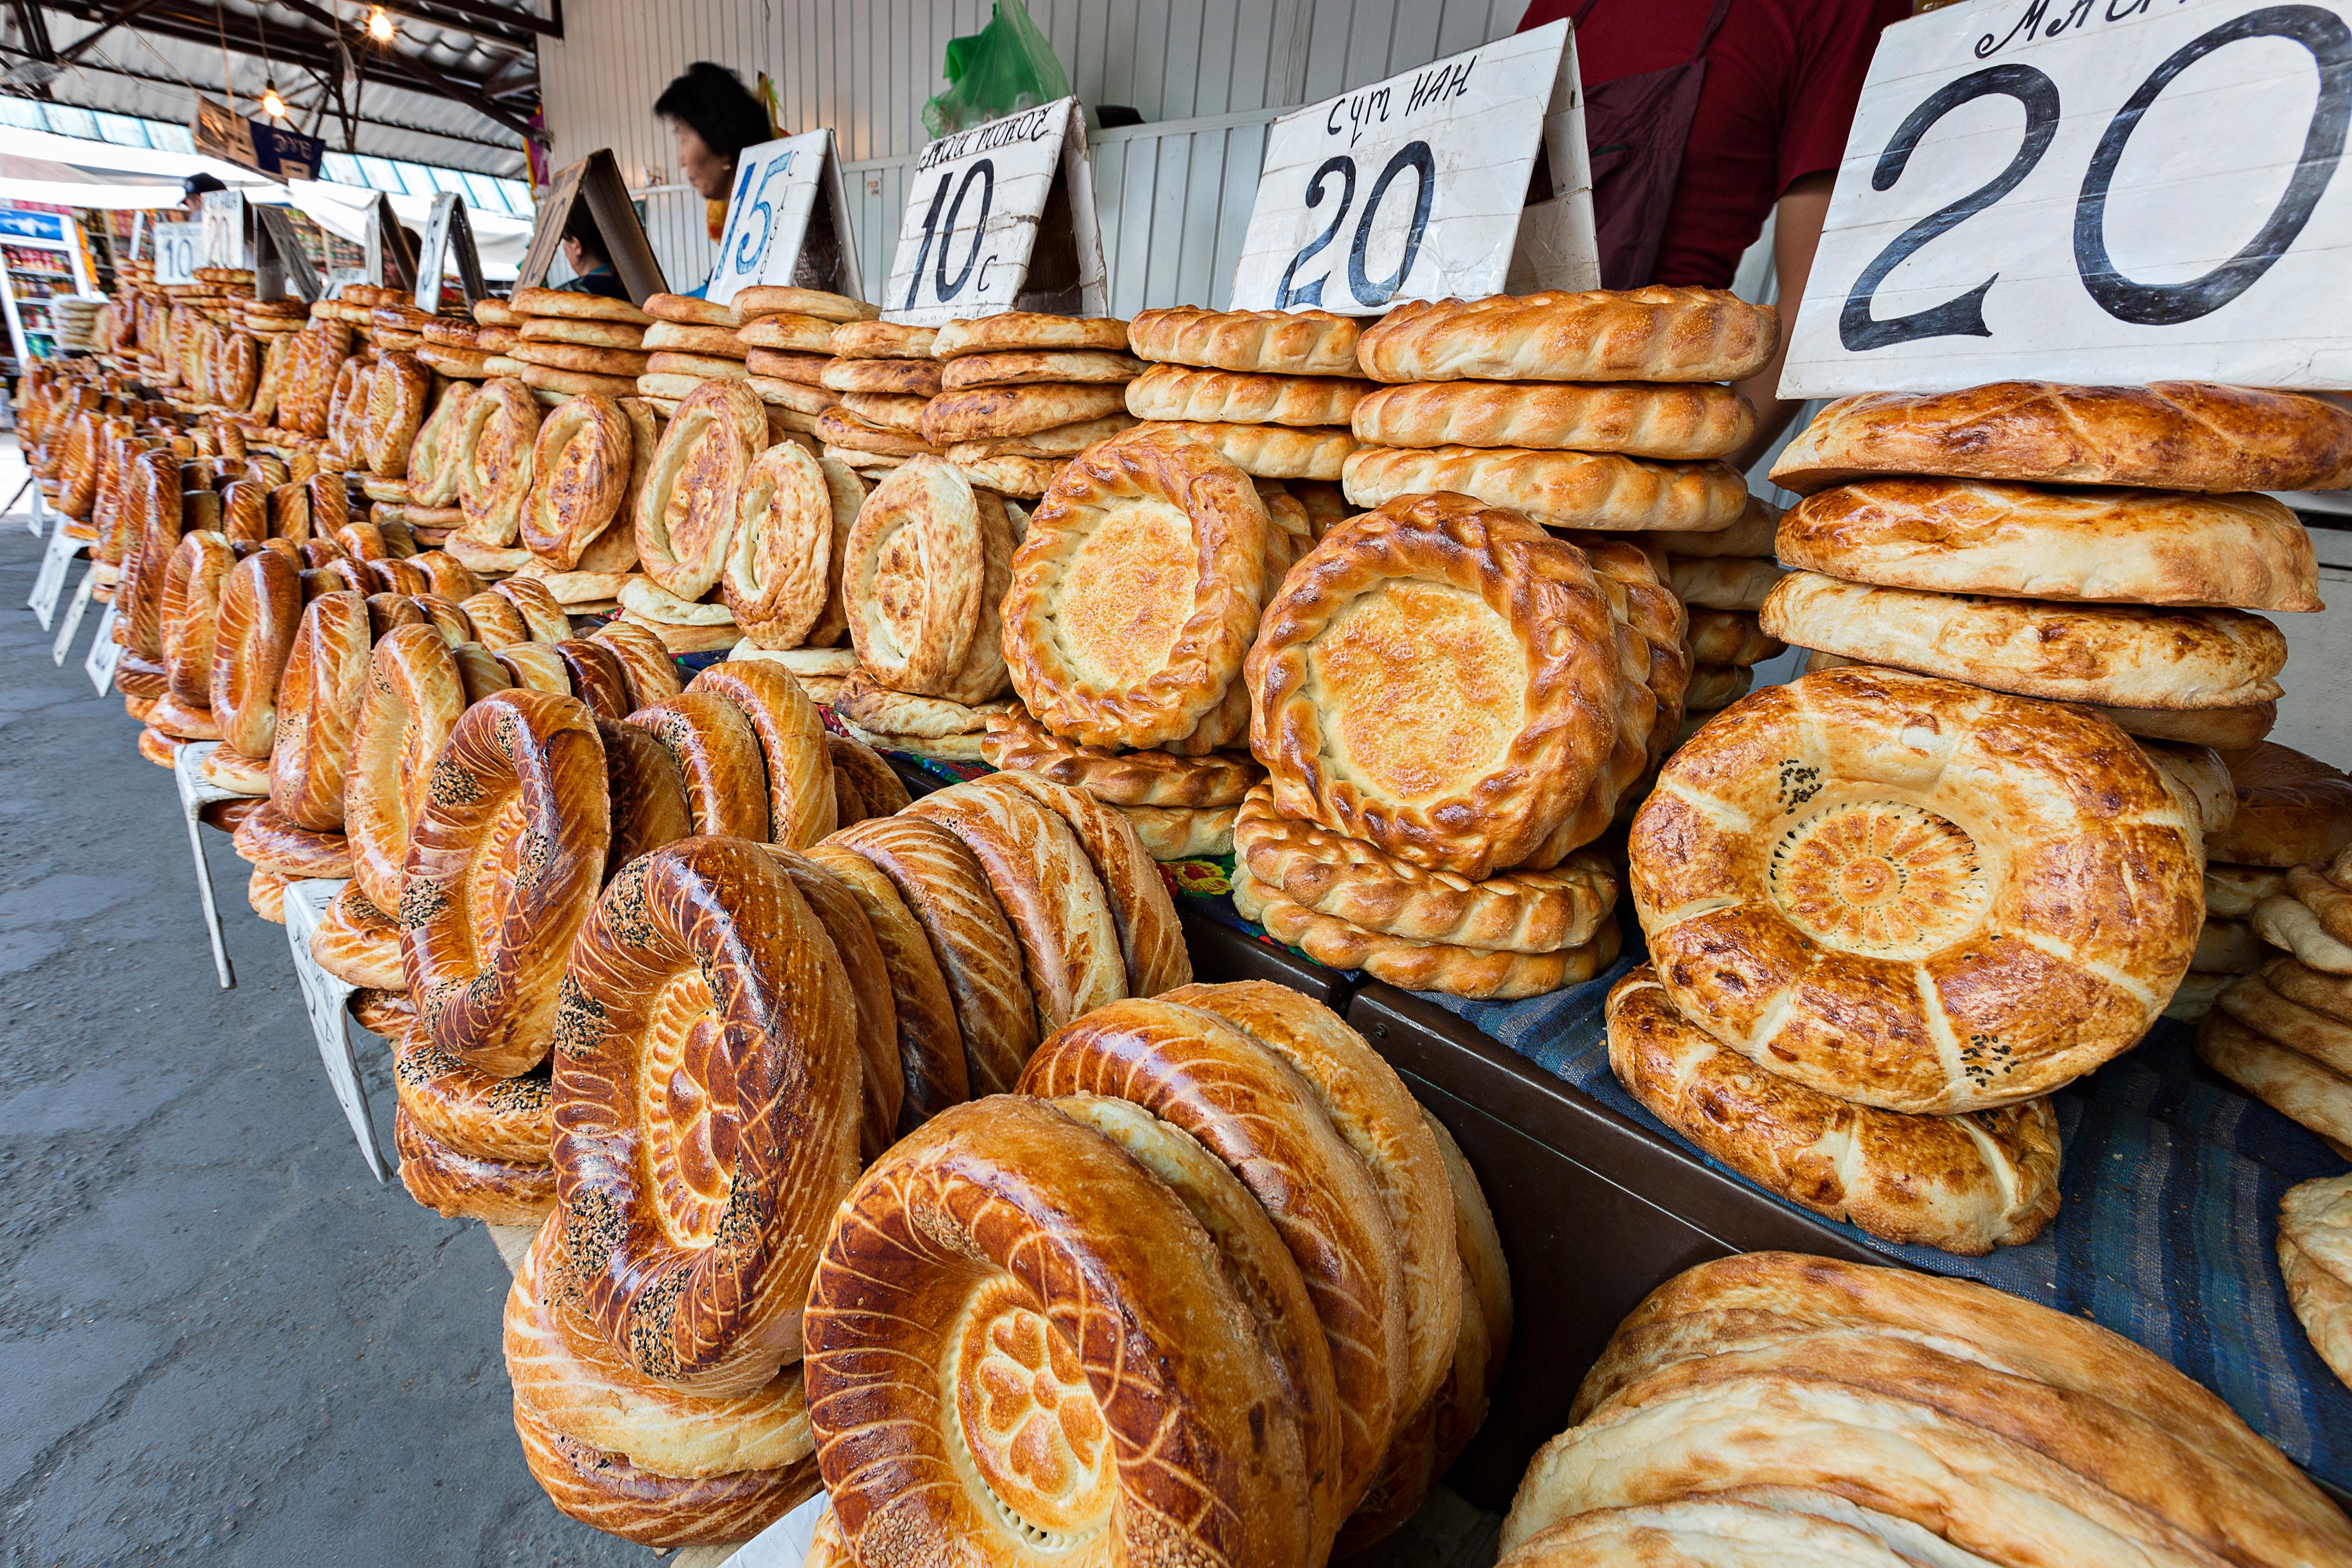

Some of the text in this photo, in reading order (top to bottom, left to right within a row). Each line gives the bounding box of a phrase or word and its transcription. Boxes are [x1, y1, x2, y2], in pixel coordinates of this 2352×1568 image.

[714, 150, 792, 280] 15
[904, 159, 994, 312] 10
[1274, 141, 1435, 310] 20
[1839, 5, 2352, 351] 20
[165, 239, 193, 278] 10
